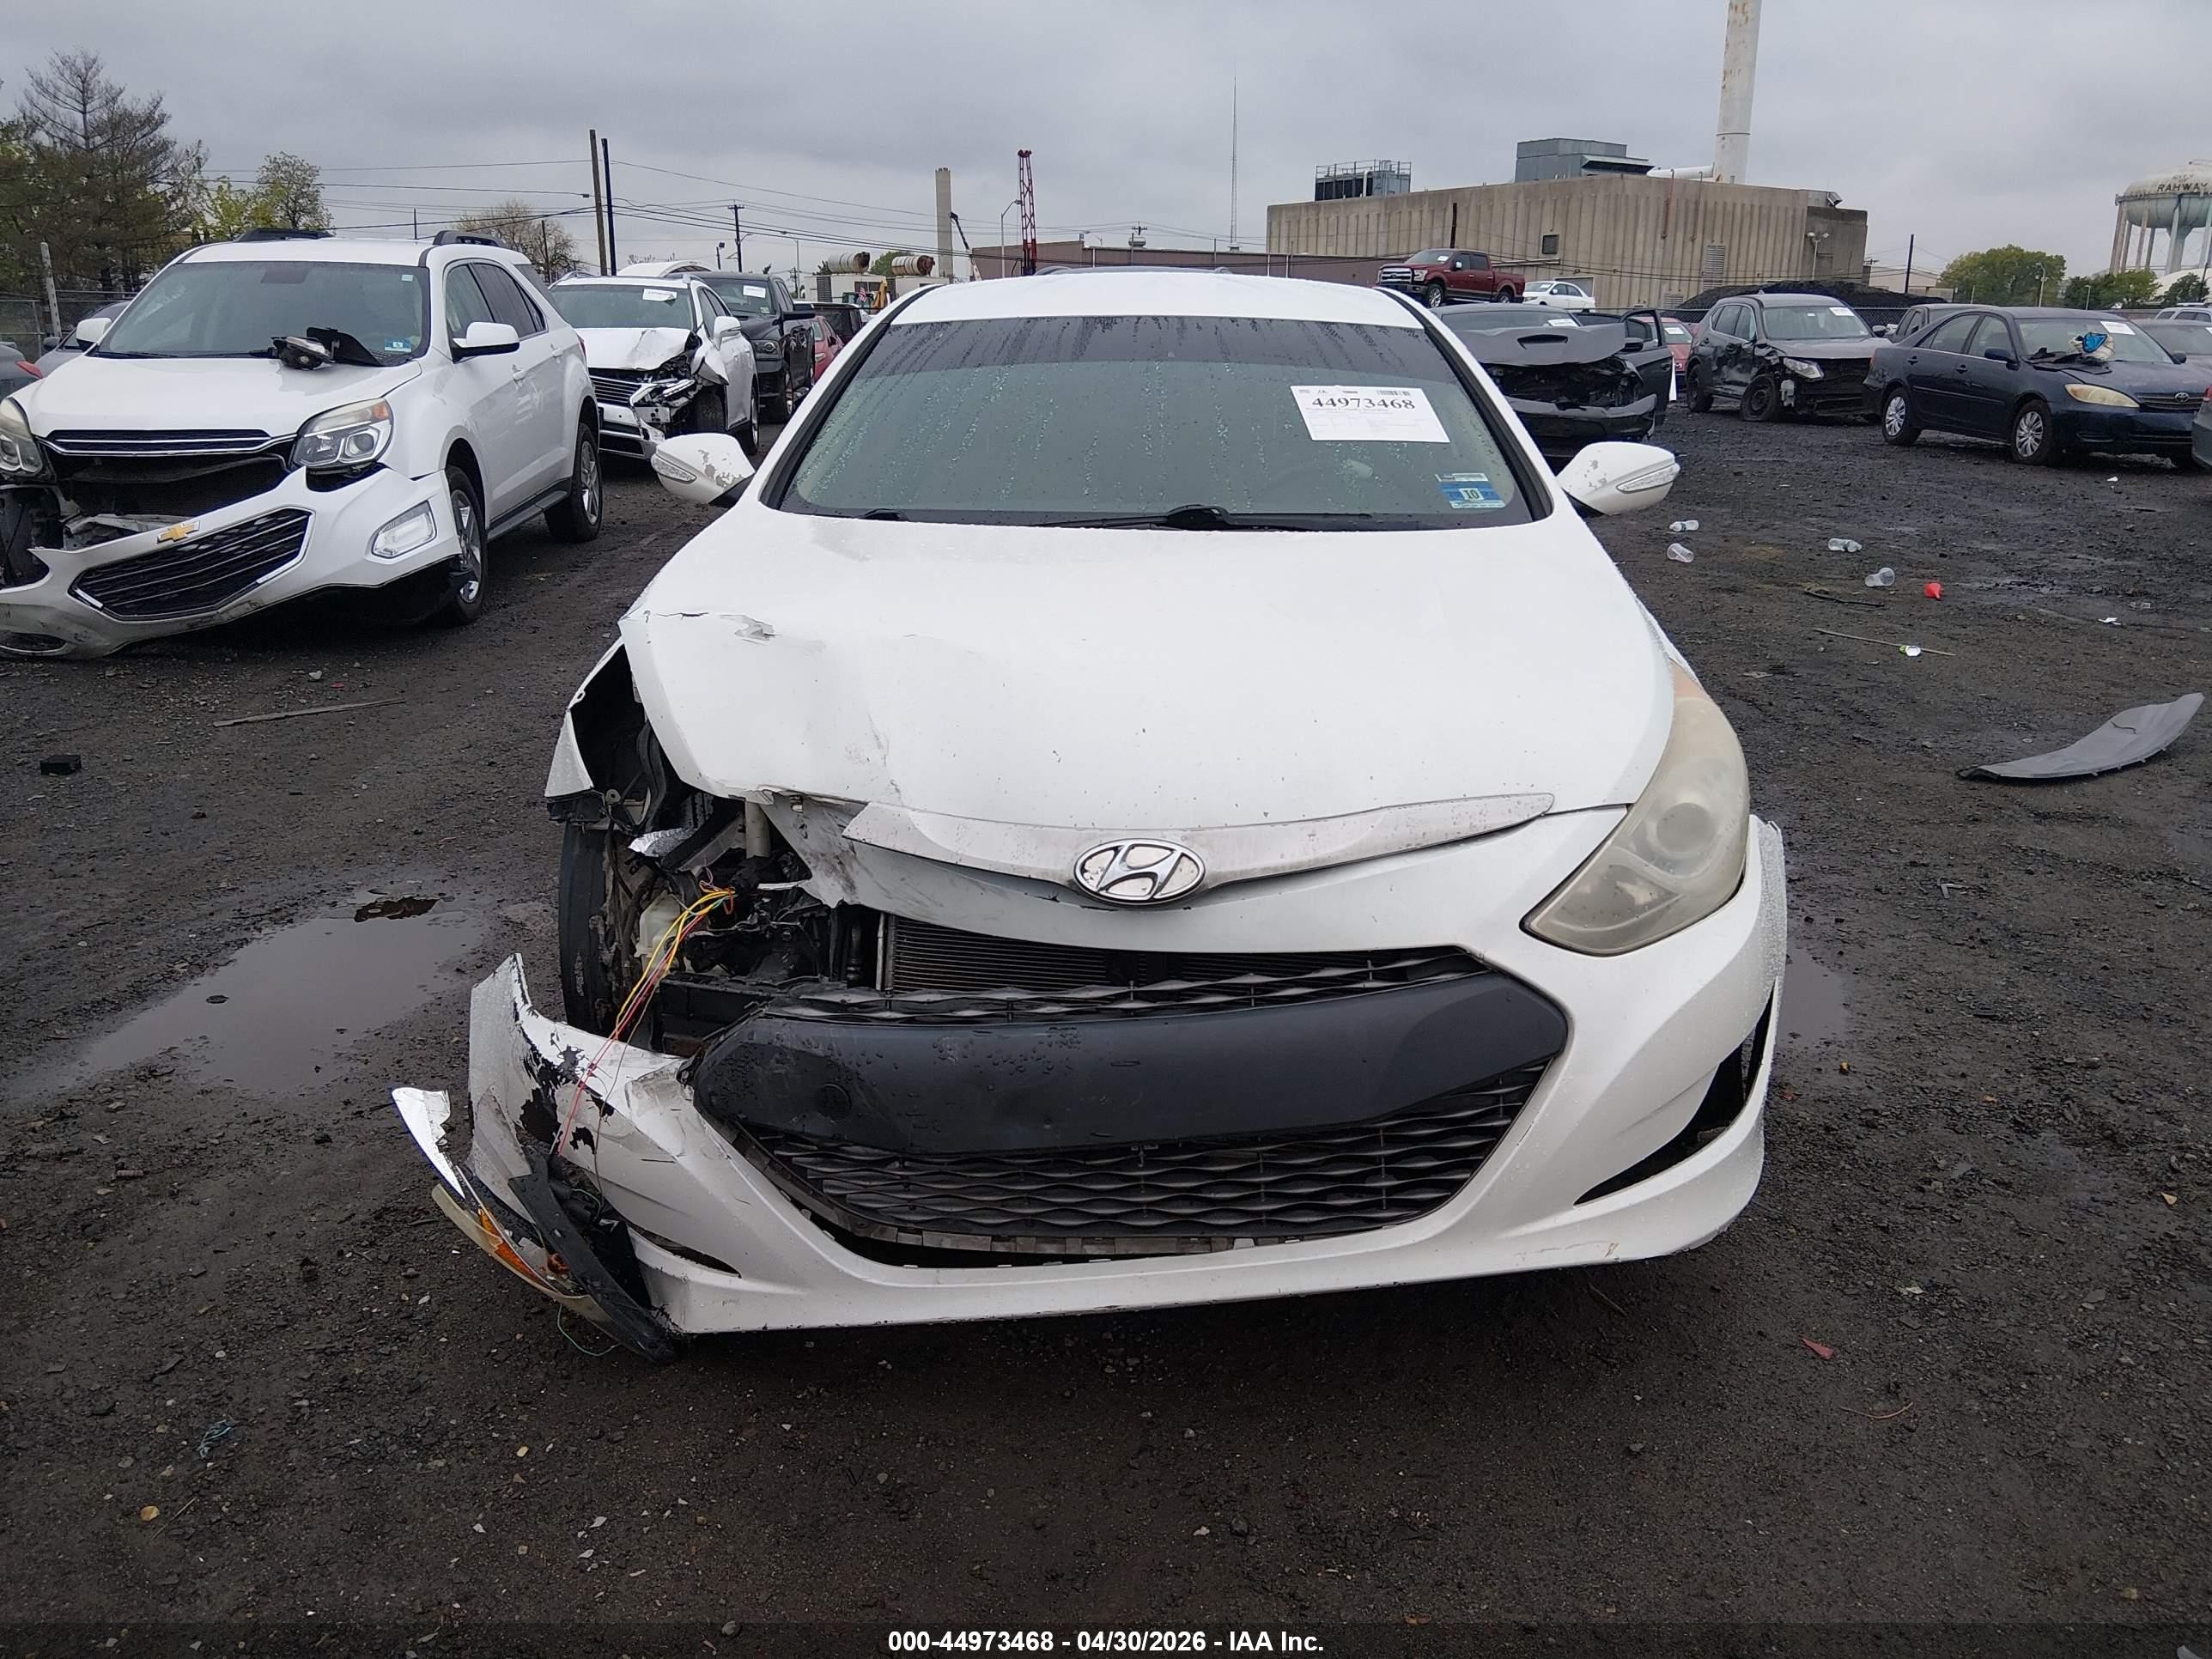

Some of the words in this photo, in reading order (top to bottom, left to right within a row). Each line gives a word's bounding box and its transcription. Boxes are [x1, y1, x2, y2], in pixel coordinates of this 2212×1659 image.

[2157, 182, 2209, 191] RAHWAY
[1311, 397, 1415, 410] 44973468
[1463, 489, 1480, 500] 10
